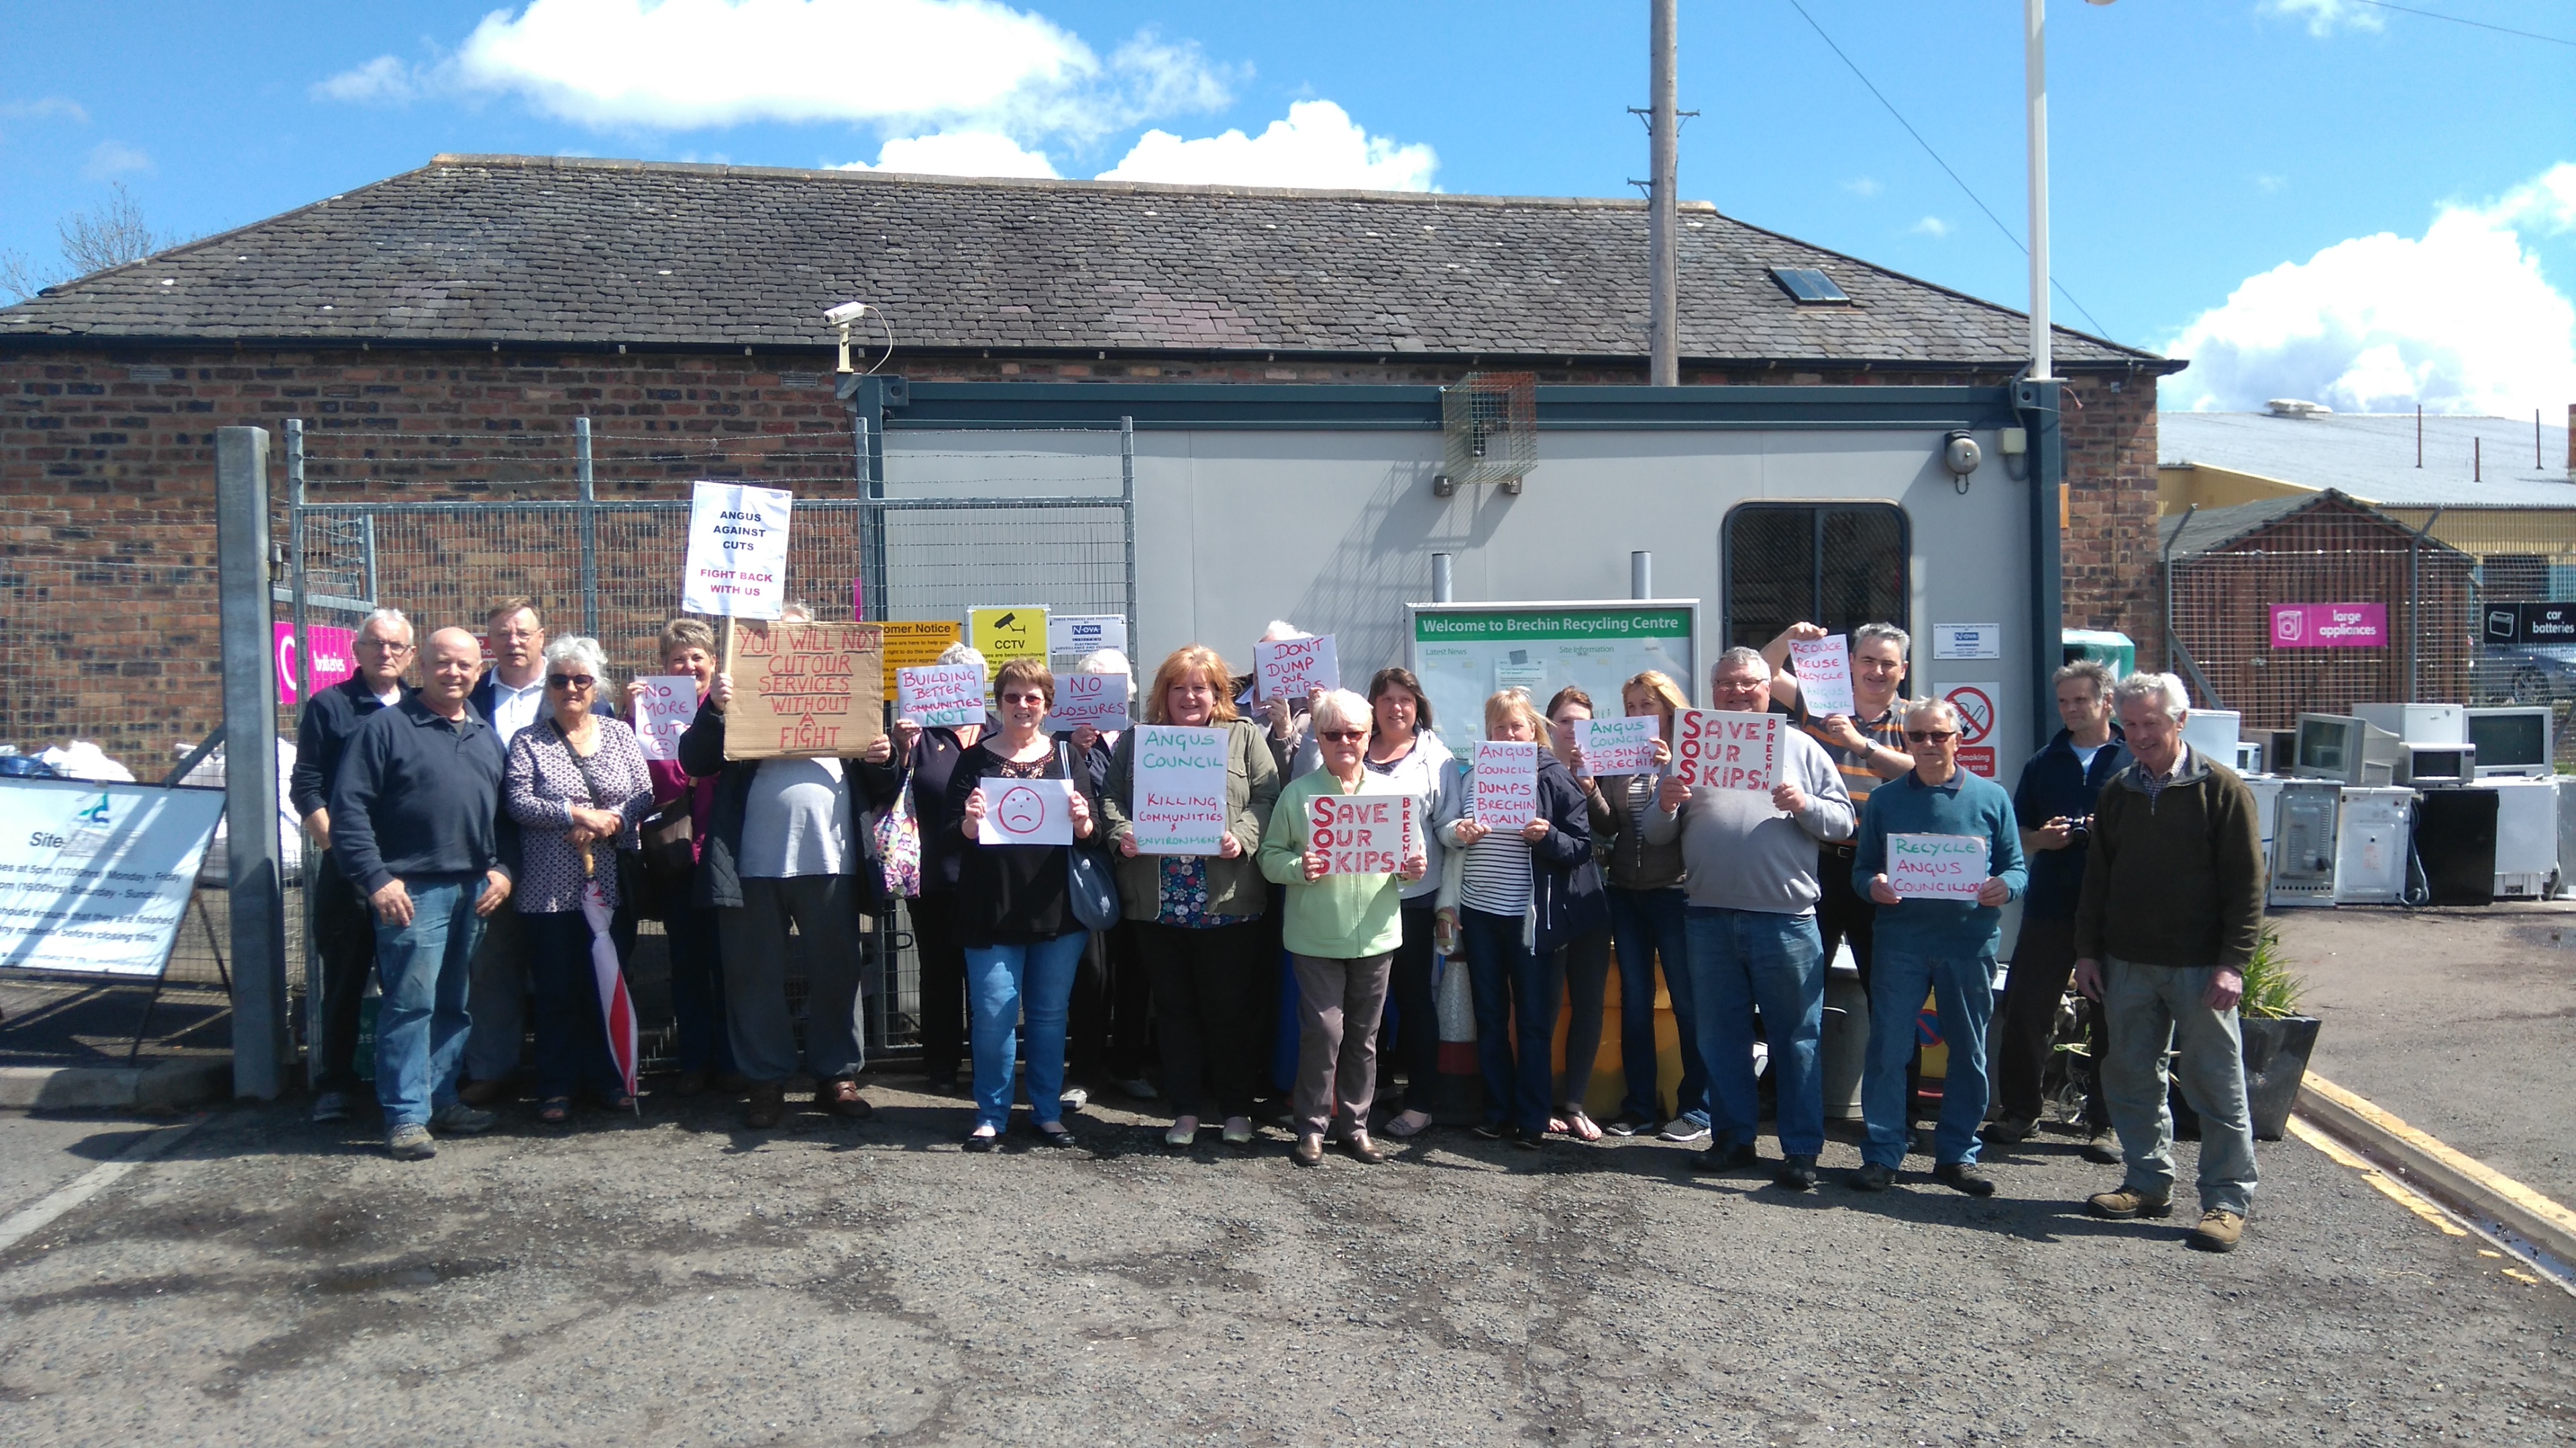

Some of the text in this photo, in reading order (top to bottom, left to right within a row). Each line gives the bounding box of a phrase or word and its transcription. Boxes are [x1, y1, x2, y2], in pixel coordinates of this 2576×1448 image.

[720, 511, 761, 522] ANGUS
[713, 525, 766, 537] AGAINST
[722, 541, 754, 551] CUTS
[700, 569, 773, 582] FIGHT BACK
[710, 585, 760, 596] WITH US
[2333, 609, 2361, 624] large
[2546, 611, 2562, 620] car
[883, 624, 951, 633] omer Notice
[1423, 616, 1678, 632] Welcome to Brechin Recycling Centre
[2319, 623, 2377, 638] appliances
[2532, 621, 2575, 634] batteries
[737, 628, 881, 654] YOU WILL NOT
[995, 640, 1025, 649] CCTV
[1791, 643, 1843, 653] REDUCE
[1275, 638, 1324, 660] DON'T
[1573, 645, 1614, 653] Information
[768, 655, 852, 674] CUT OUR
[1265, 657, 1314, 677] DUMP
[1798, 657, 1839, 668] REUSE
[902, 671, 976, 687] BUILDING
[1281, 672, 1305, 683] OUR
[1796, 669, 1844, 683] RECYCLE
[645, 683, 672, 699] NO
[759, 676, 849, 693] SERVICES
[912, 683, 965, 700] BETTER
[1070, 677, 1102, 693] NO
[1807, 687, 1845, 698] ANGUS
[641, 701, 689, 716] MORE
[771, 696, 852, 712] WITHOUT
[904, 698, 983, 713] COMMUNITIES
[1050, 702, 1126, 718] CLOSURES
[1809, 701, 1851, 709] COUNCIL
[799, 712, 816, 726] A
[926, 709, 967, 724] NOT
[1591, 722, 1645, 734] ANGUS
[1682, 711, 1761, 740] SAVE
[780, 726, 841, 748] FIGHT
[1144, 731, 1216, 751] ANGUS
[1591, 736, 1648, 748] COUNCIL
[1479, 745, 1534, 761] ANGUS
[1583, 746, 1650, 759] CLOSING
[1680, 740, 1740, 762] OUR
[1762, 718, 1776, 790] BRECHIN
[1956, 754, 1990, 763] Smoking
[1143, 753, 1224, 769] COUNCIL
[1477, 763, 1532, 775] COUNCIL
[1676, 759, 1762, 790] SKIPS
[1479, 781, 1532, 795] DUMPS
[1147, 793, 1217, 811] KILLING
[1477, 797, 1535, 810] BRECHIN
[1139, 811, 1223, 822] COMMUNITIES
[1311, 796, 1389, 828] SAVE
[1479, 812, 1525, 825] AGAIN
[30, 832, 63, 848] Site
[1313, 828, 1373, 849] OUR
[1895, 838, 1976, 856] RECYCLE
[1312, 849, 1396, 875] SKIPS
[1896, 860, 1962, 877] ANGUS
[0, 864, 13, 872] es
[107, 871, 146, 883] Monday
[154, 871, 182, 883] Friday
[70, 886, 116, 899] Saturday
[125, 888, 163, 901] Sunday
[0, 907, 31, 917] hould
